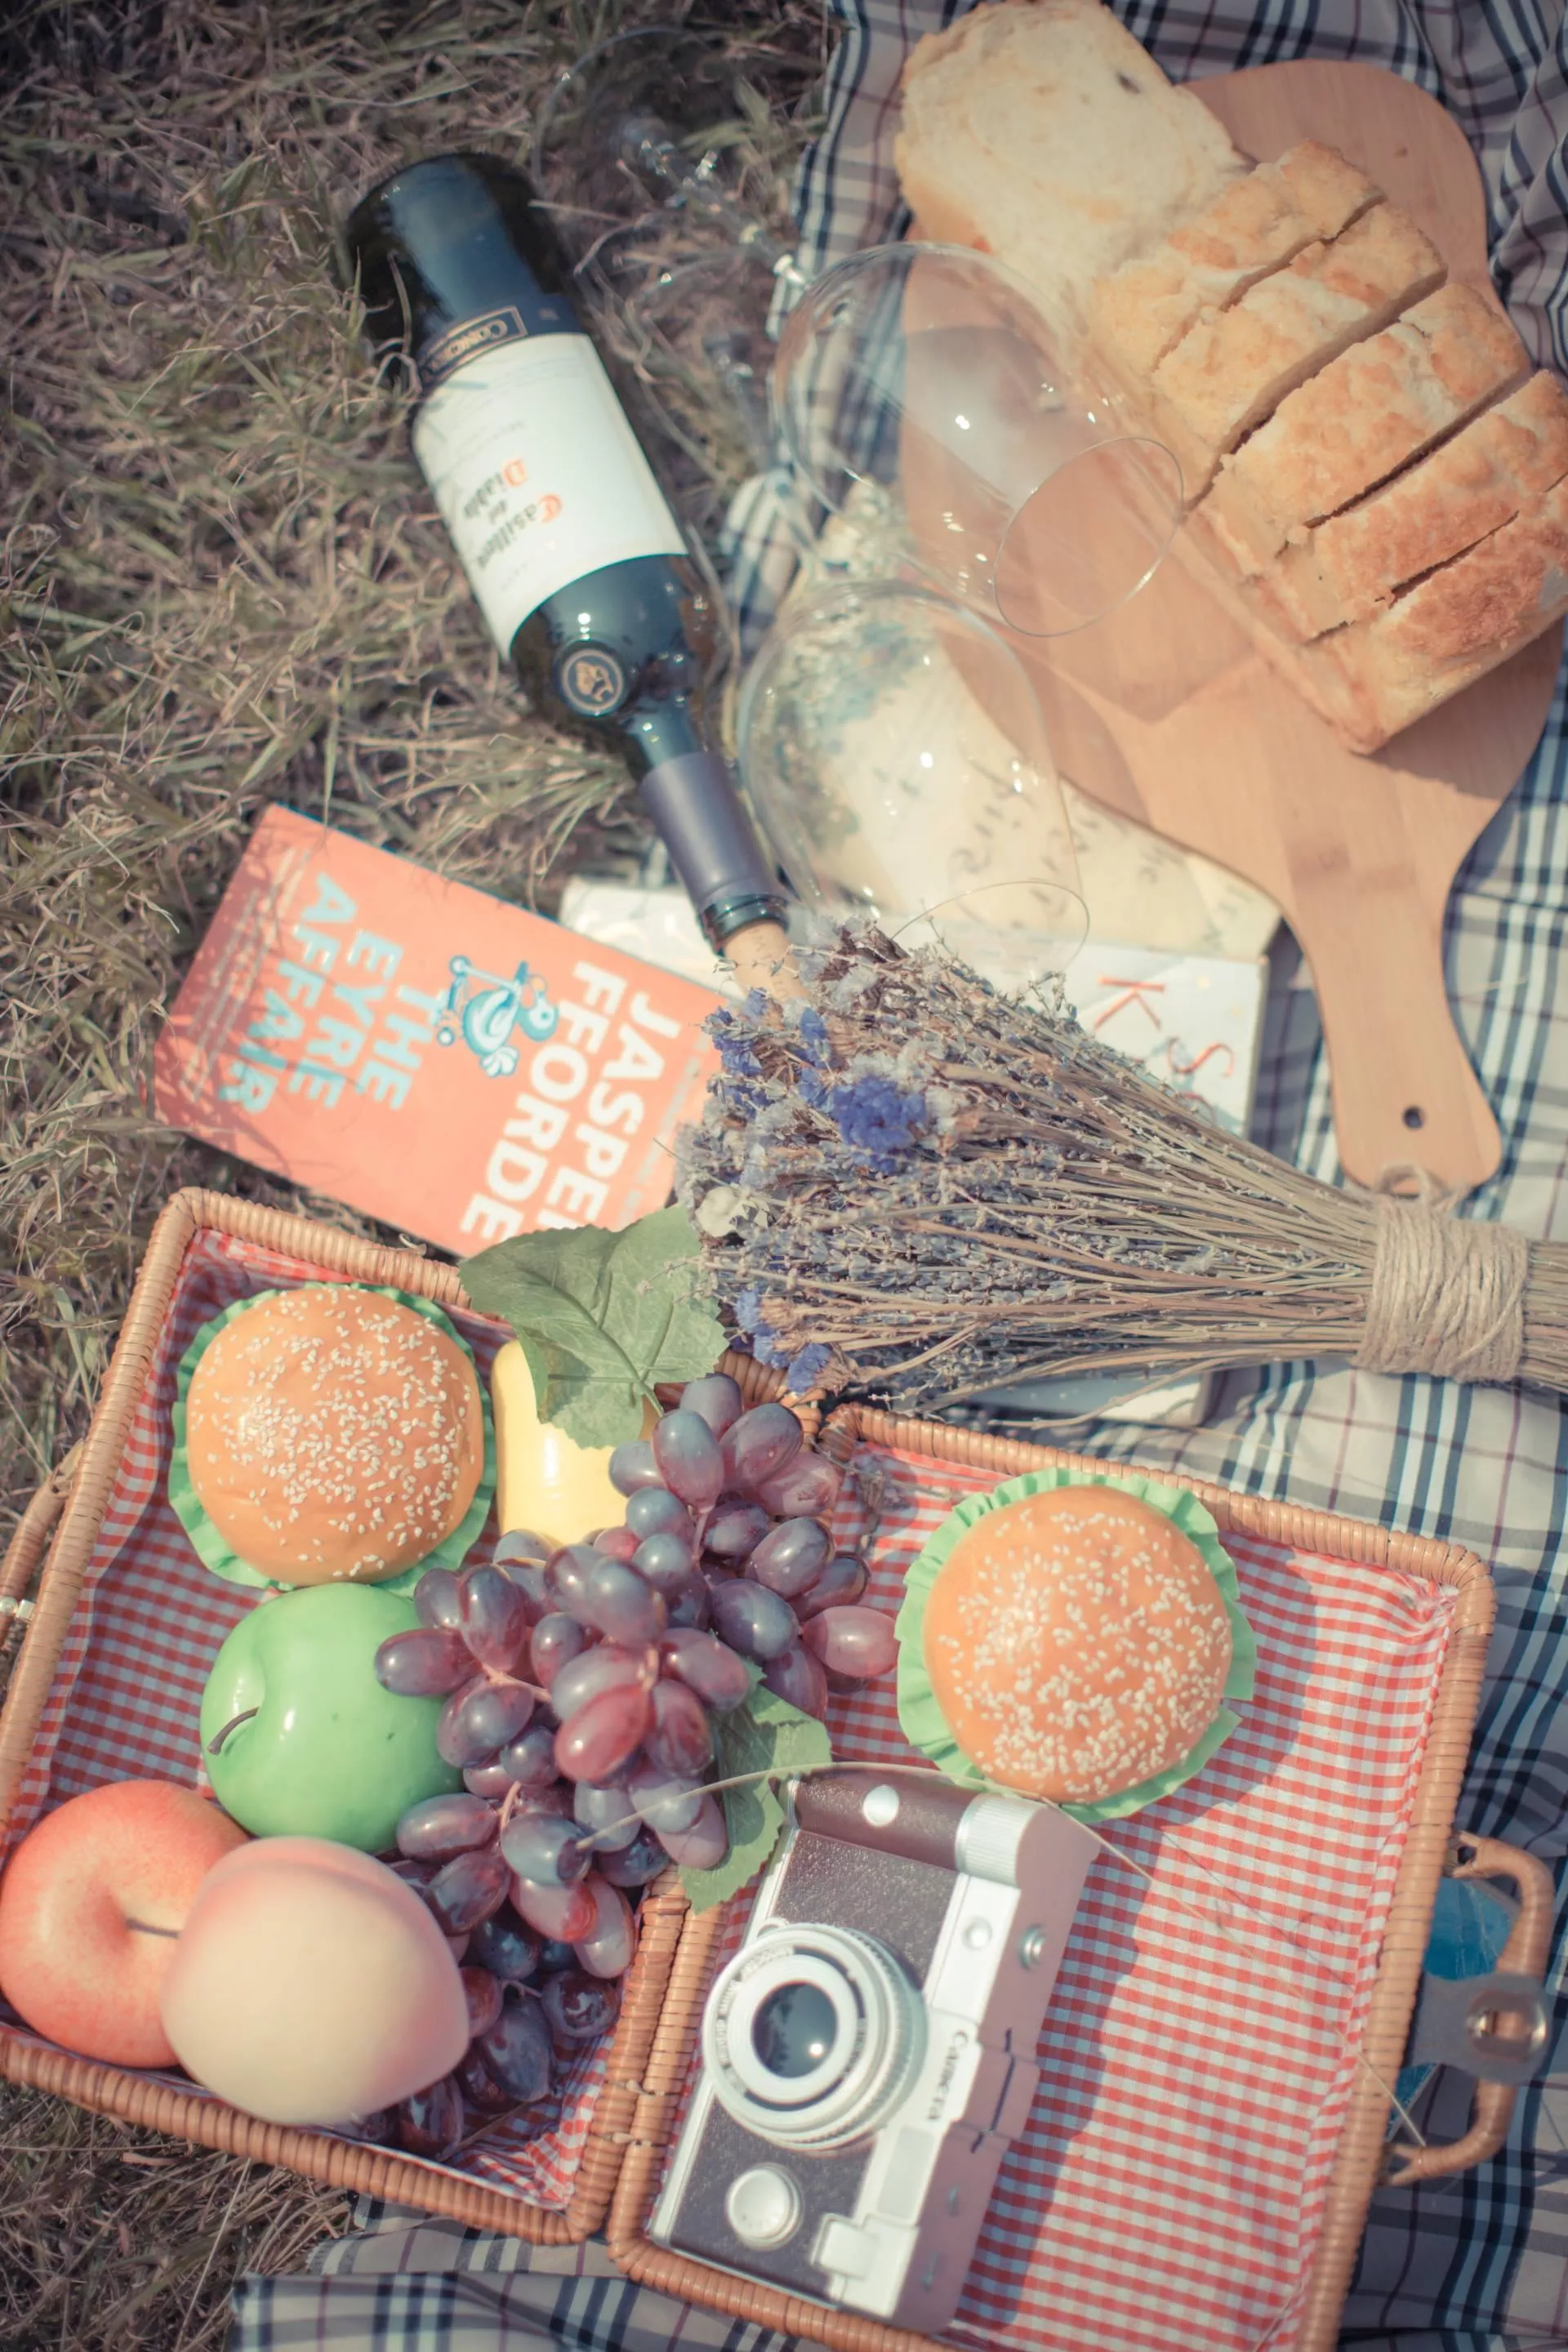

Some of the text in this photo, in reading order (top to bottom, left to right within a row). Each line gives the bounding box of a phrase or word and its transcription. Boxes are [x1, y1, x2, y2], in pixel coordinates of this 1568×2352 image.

[220, 873, 357, 1113] AFFAIR
[289, 929, 403, 1108] EYRE
[356, 983, 445, 1108] THE
[461, 962, 628, 1240] FFORDE
